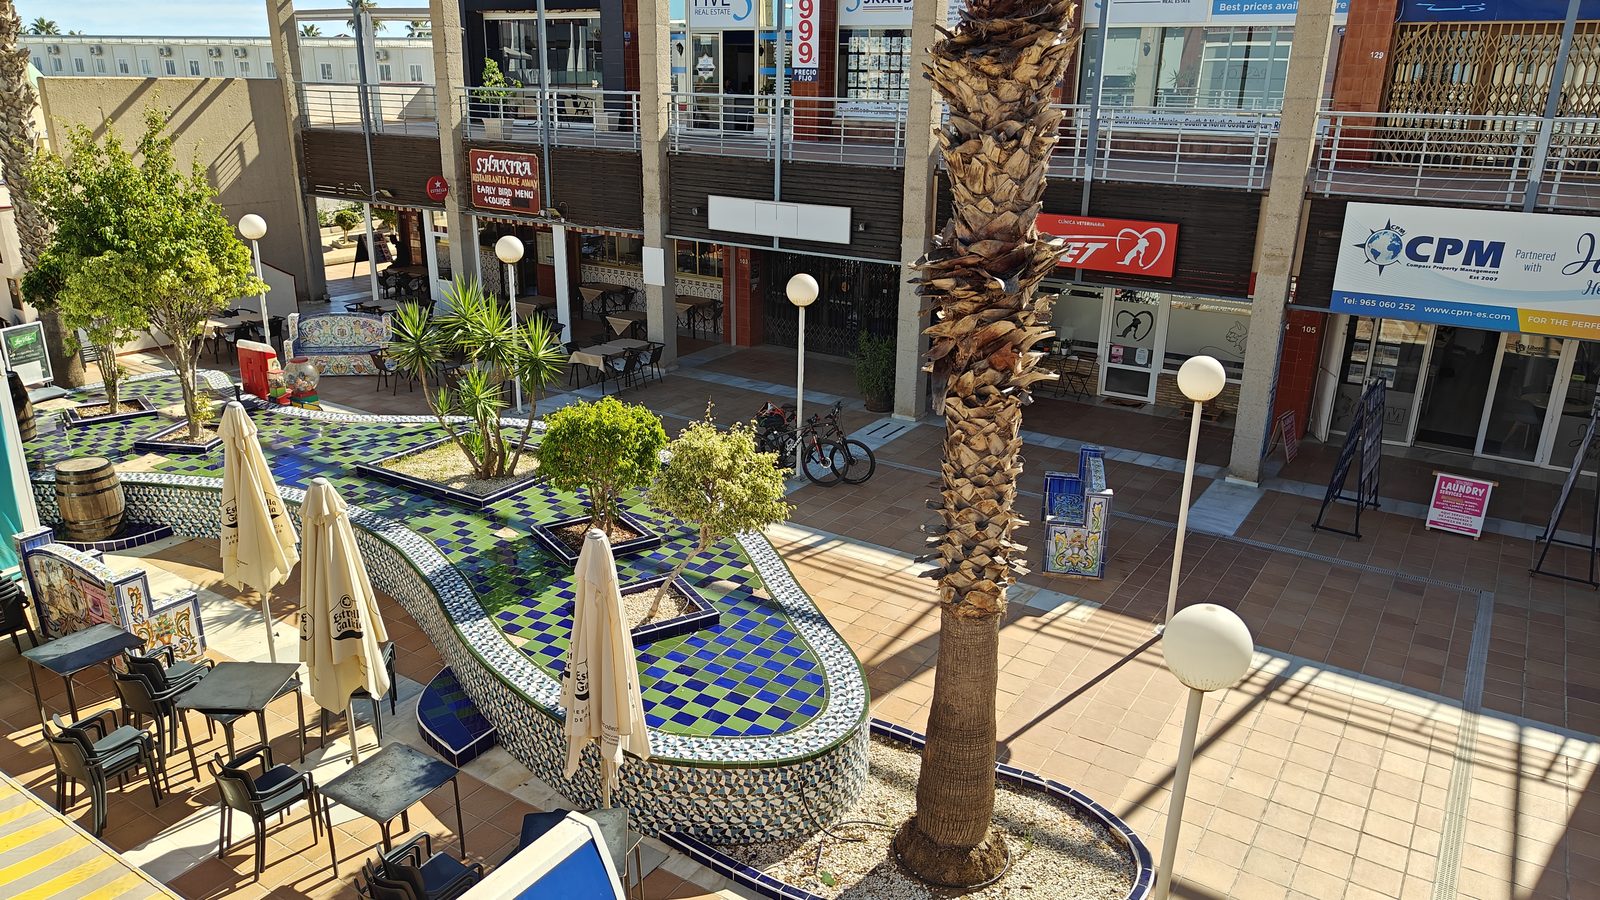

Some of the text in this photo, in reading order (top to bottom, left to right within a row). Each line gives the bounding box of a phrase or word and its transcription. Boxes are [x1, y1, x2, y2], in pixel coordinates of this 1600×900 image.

[1219, 3, 1241, 11] Best
[1243, 3, 1273, 12] prices
[1275, 1, 1299, 10] avail
[1370, 51, 1384, 59] 129
[1246, 120, 1268, 129] Blaca
[476, 154, 532, 177] SHAKIRA
[520, 178, 538, 191] AWAY
[476, 185, 534, 199] EARLY BIRD MENU
[1390, 224, 1407, 235] CPM
[1059, 241, 1108, 264] ET
[1405, 236, 1506, 269] CPM
[1515, 248, 1557, 262] Partnered
[1406, 262, 1431, 270] Compass
[1459, 267, 1499, 275] Management
[1523, 262, 1542, 273] with
[1342, 297, 1511, 321] Tel: 965 060 252 www.cpm-es.com
[1301, 325, 1317, 334] 105
[1528, 316, 1600, 330] FOR THE PERFE
[1441, 481, 1486, 497] LAUNDRY
[333, 609, 360, 623] Estrell
